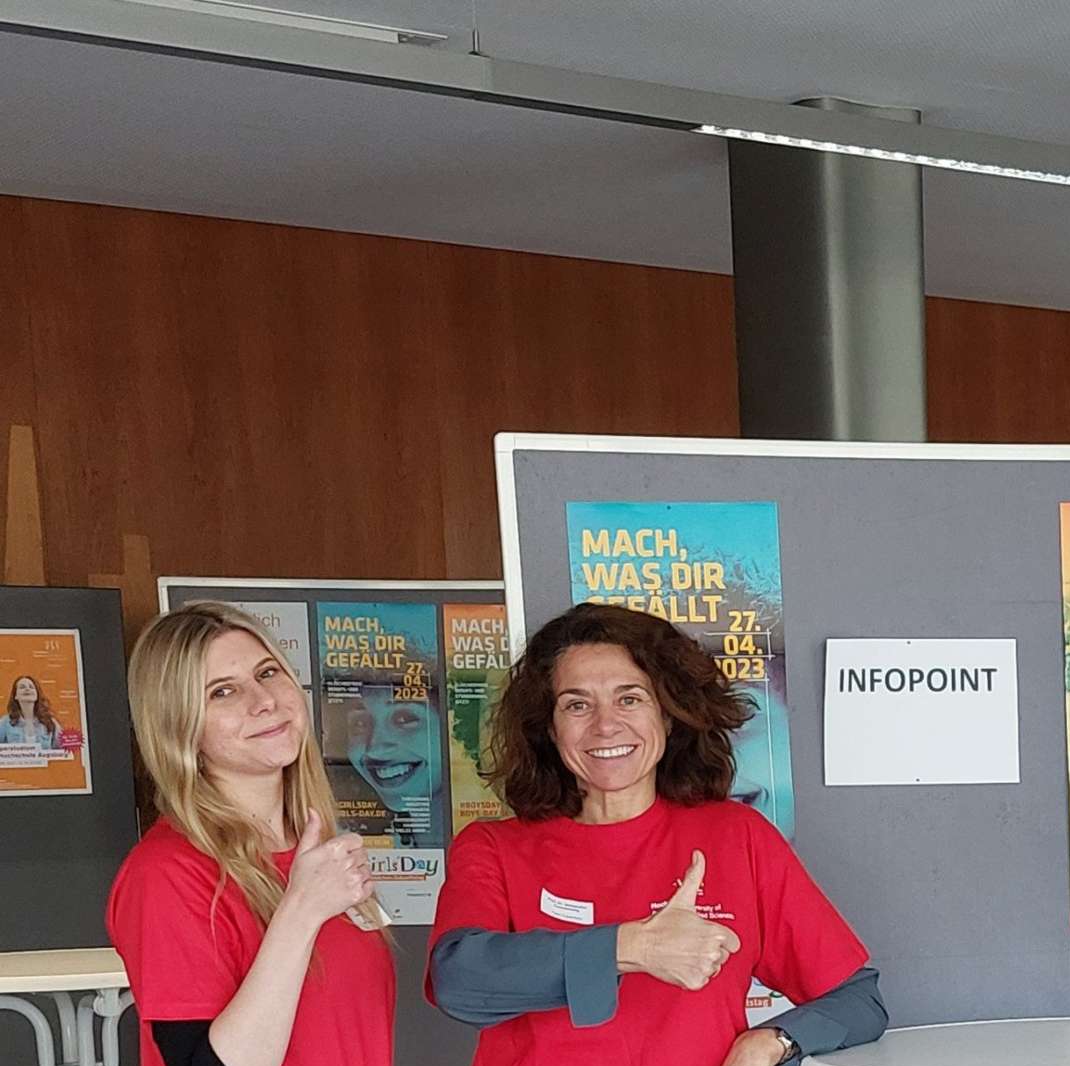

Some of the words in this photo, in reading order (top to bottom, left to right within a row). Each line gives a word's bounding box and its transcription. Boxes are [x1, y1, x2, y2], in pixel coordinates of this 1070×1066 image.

[581, 529, 687, 561] MACH,
[582, 563, 661, 591] WAS
[671, 563, 726, 590] DIR
[324, 616, 384, 634] MACH,
[451, 618, 508, 636] MACH,
[728, 611, 761, 632] 27.
[325, 634, 370, 650] WAS
[375, 635, 406, 650] DIR
[451, 635, 495, 651] WAS
[724, 635, 763, 655] 04.
[326, 648, 404, 669] GEFÄLLT
[406, 662, 426, 674] 27.
[714, 658, 765, 679] 023
[403, 674, 427, 687] 04.
[839, 668, 998, 693] INFOPOINT
[394, 687, 428, 700] 2023
